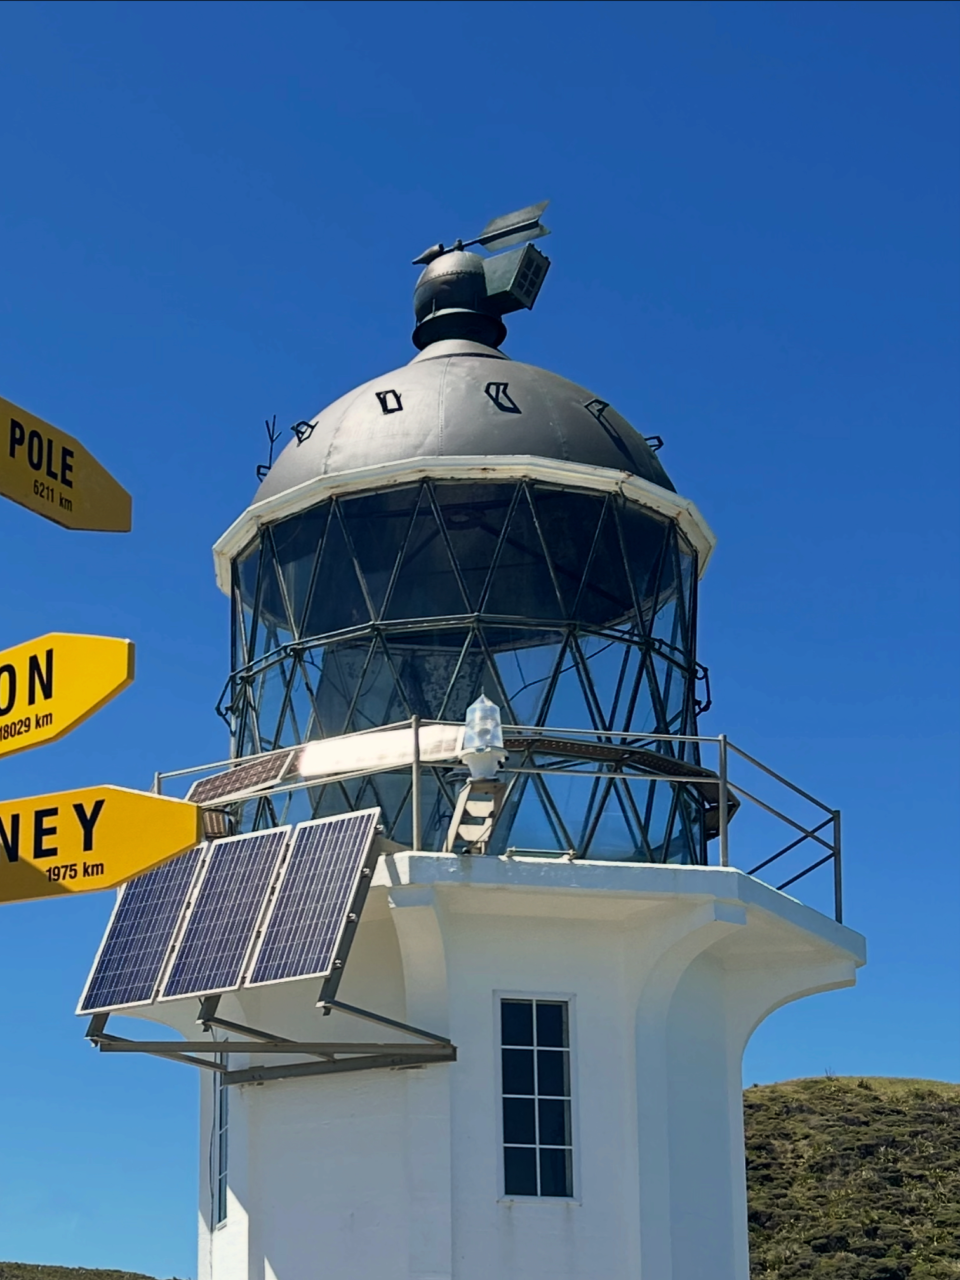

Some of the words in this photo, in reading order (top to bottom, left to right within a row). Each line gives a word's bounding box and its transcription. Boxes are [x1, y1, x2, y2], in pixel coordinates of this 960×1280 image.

[9, 418, 74, 489] POLE
[33, 479, 54, 503] 6211
[59, 491, 73, 512] km
[34, 711, 53, 729] km
[45, 864, 78, 883] 1975
[82, 861, 105, 878] km
